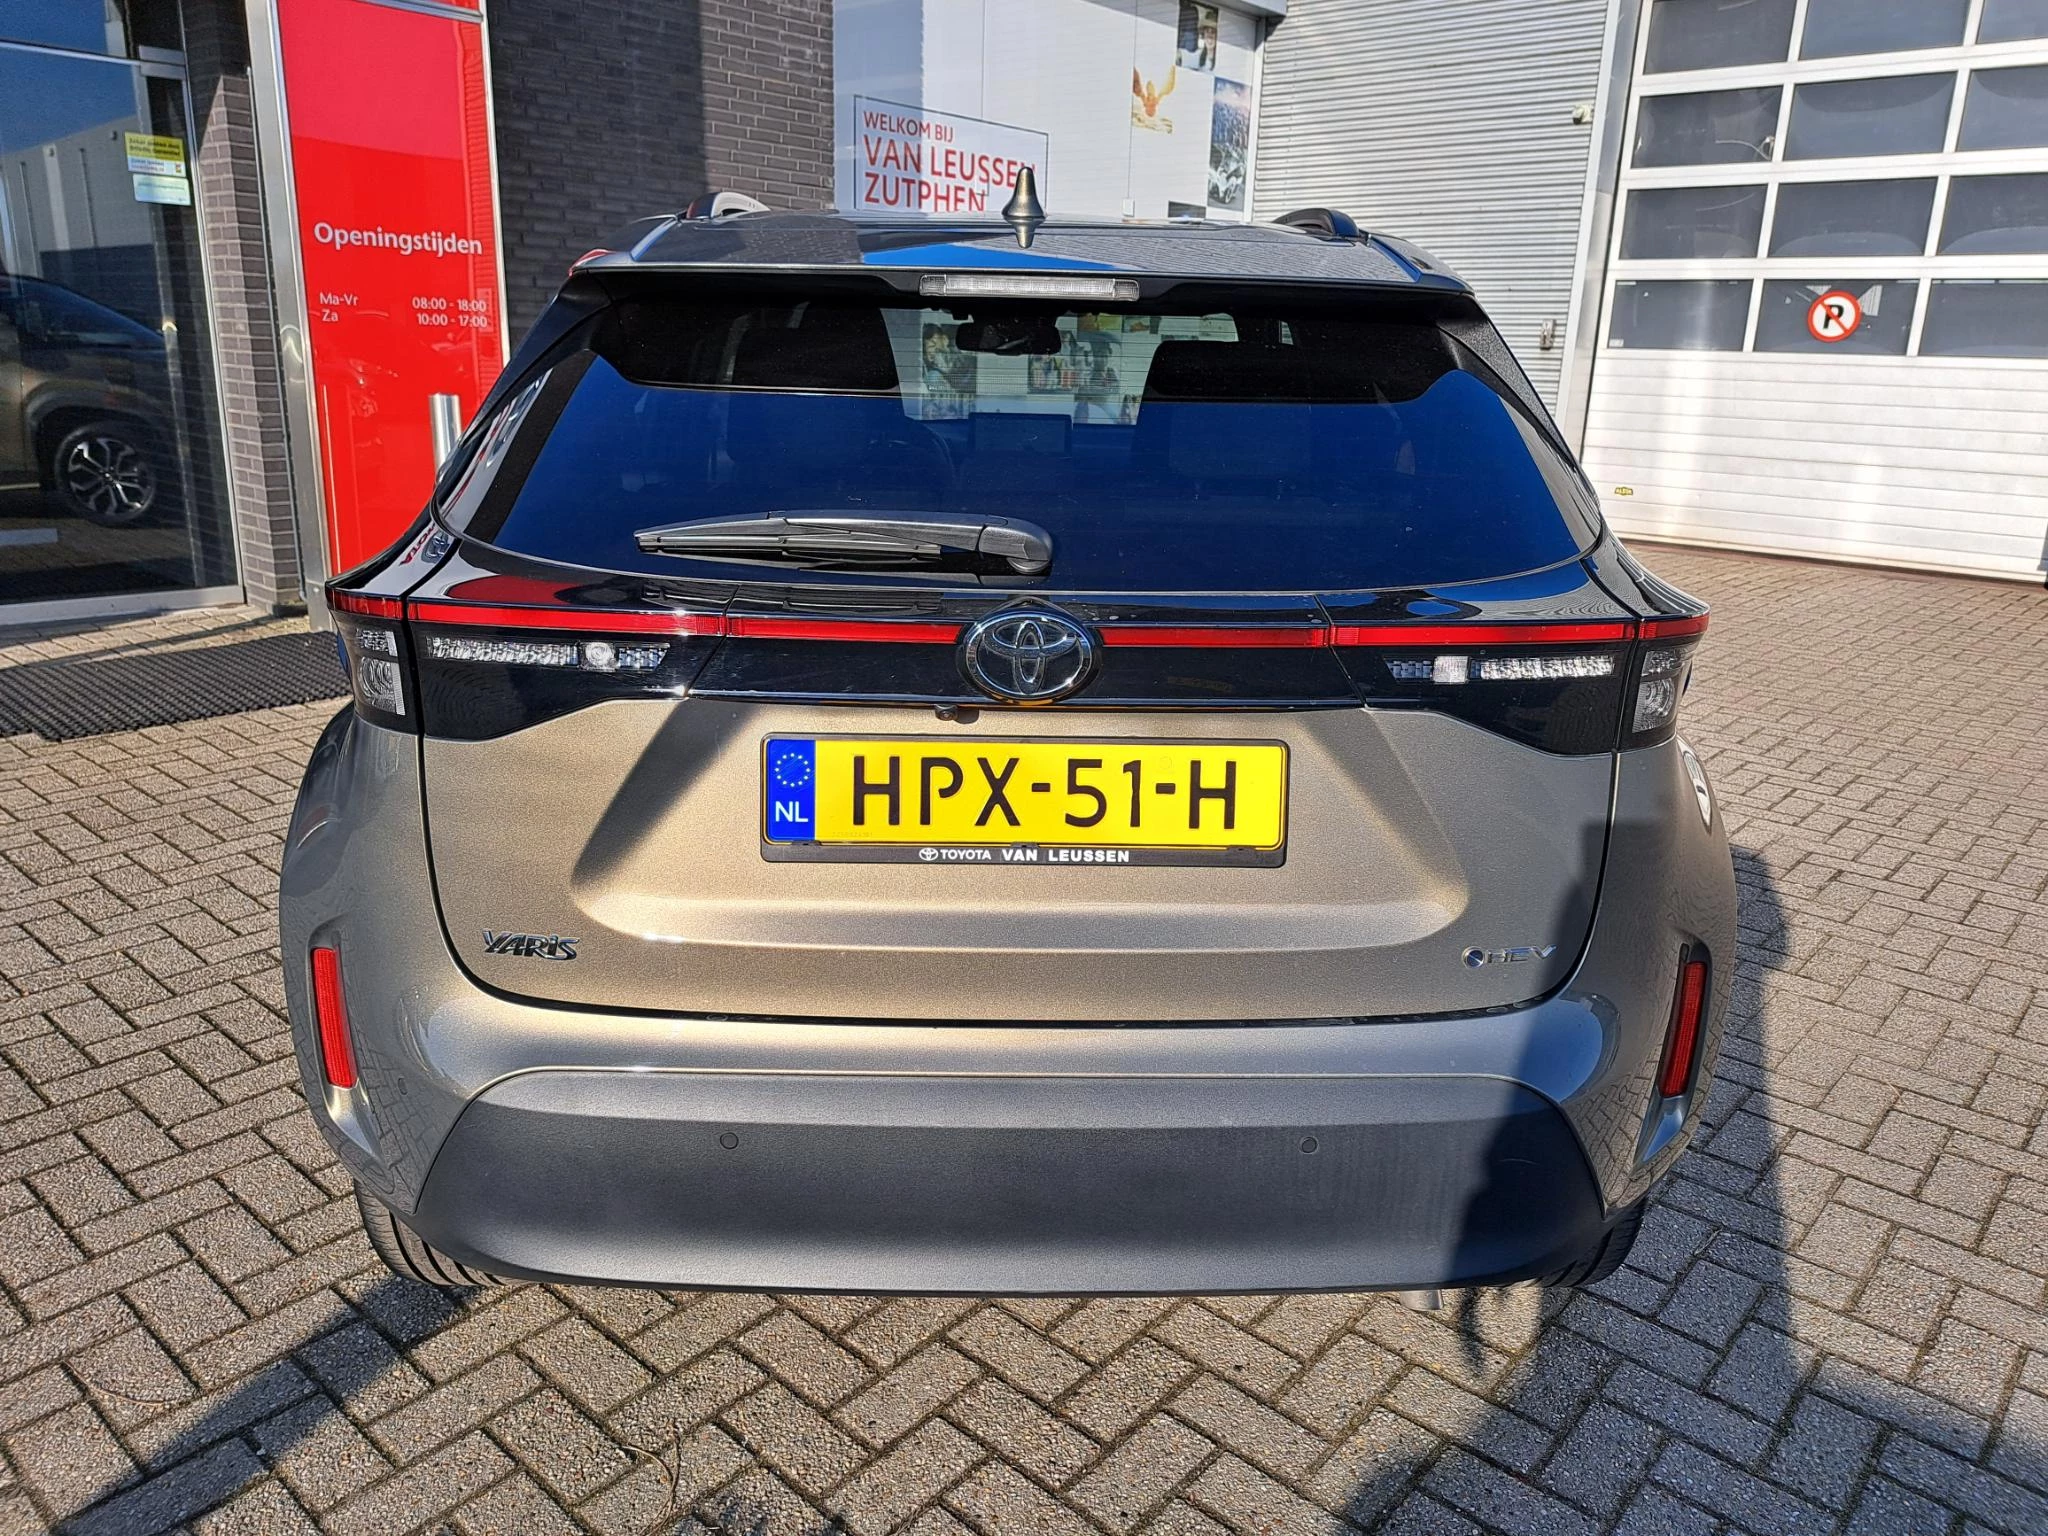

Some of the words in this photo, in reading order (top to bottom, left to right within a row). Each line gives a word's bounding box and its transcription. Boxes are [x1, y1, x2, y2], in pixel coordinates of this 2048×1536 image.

[863, 111, 931, 138] WELKOM
[934, 124, 955, 143] BIJ
[863, 134, 922, 174] VAN
[930, 146, 1036, 189] LEUSSE
[864, 171, 986, 213] ZUTPHEN
[314, 222, 483, 258] Openingstijden
[319, 292, 359, 306] Ma-Vr
[412, 296, 447, 311] 08:00
[457, 298, 487, 313] 18:00
[322, 308, 339, 323] Za
[417, 313, 448, 327] 10:00
[459, 314, 488, 328] 17:00
[853, 755, 1237, 830] HPX-51-H
[775, 801, 809, 823] NL
[940, 848, 992, 861] TOYOTA
[1002, 848, 1038, 861] VAN
[1048, 849, 1129, 863] LEUSSEN
[1484, 945, 1558, 964] HEV
